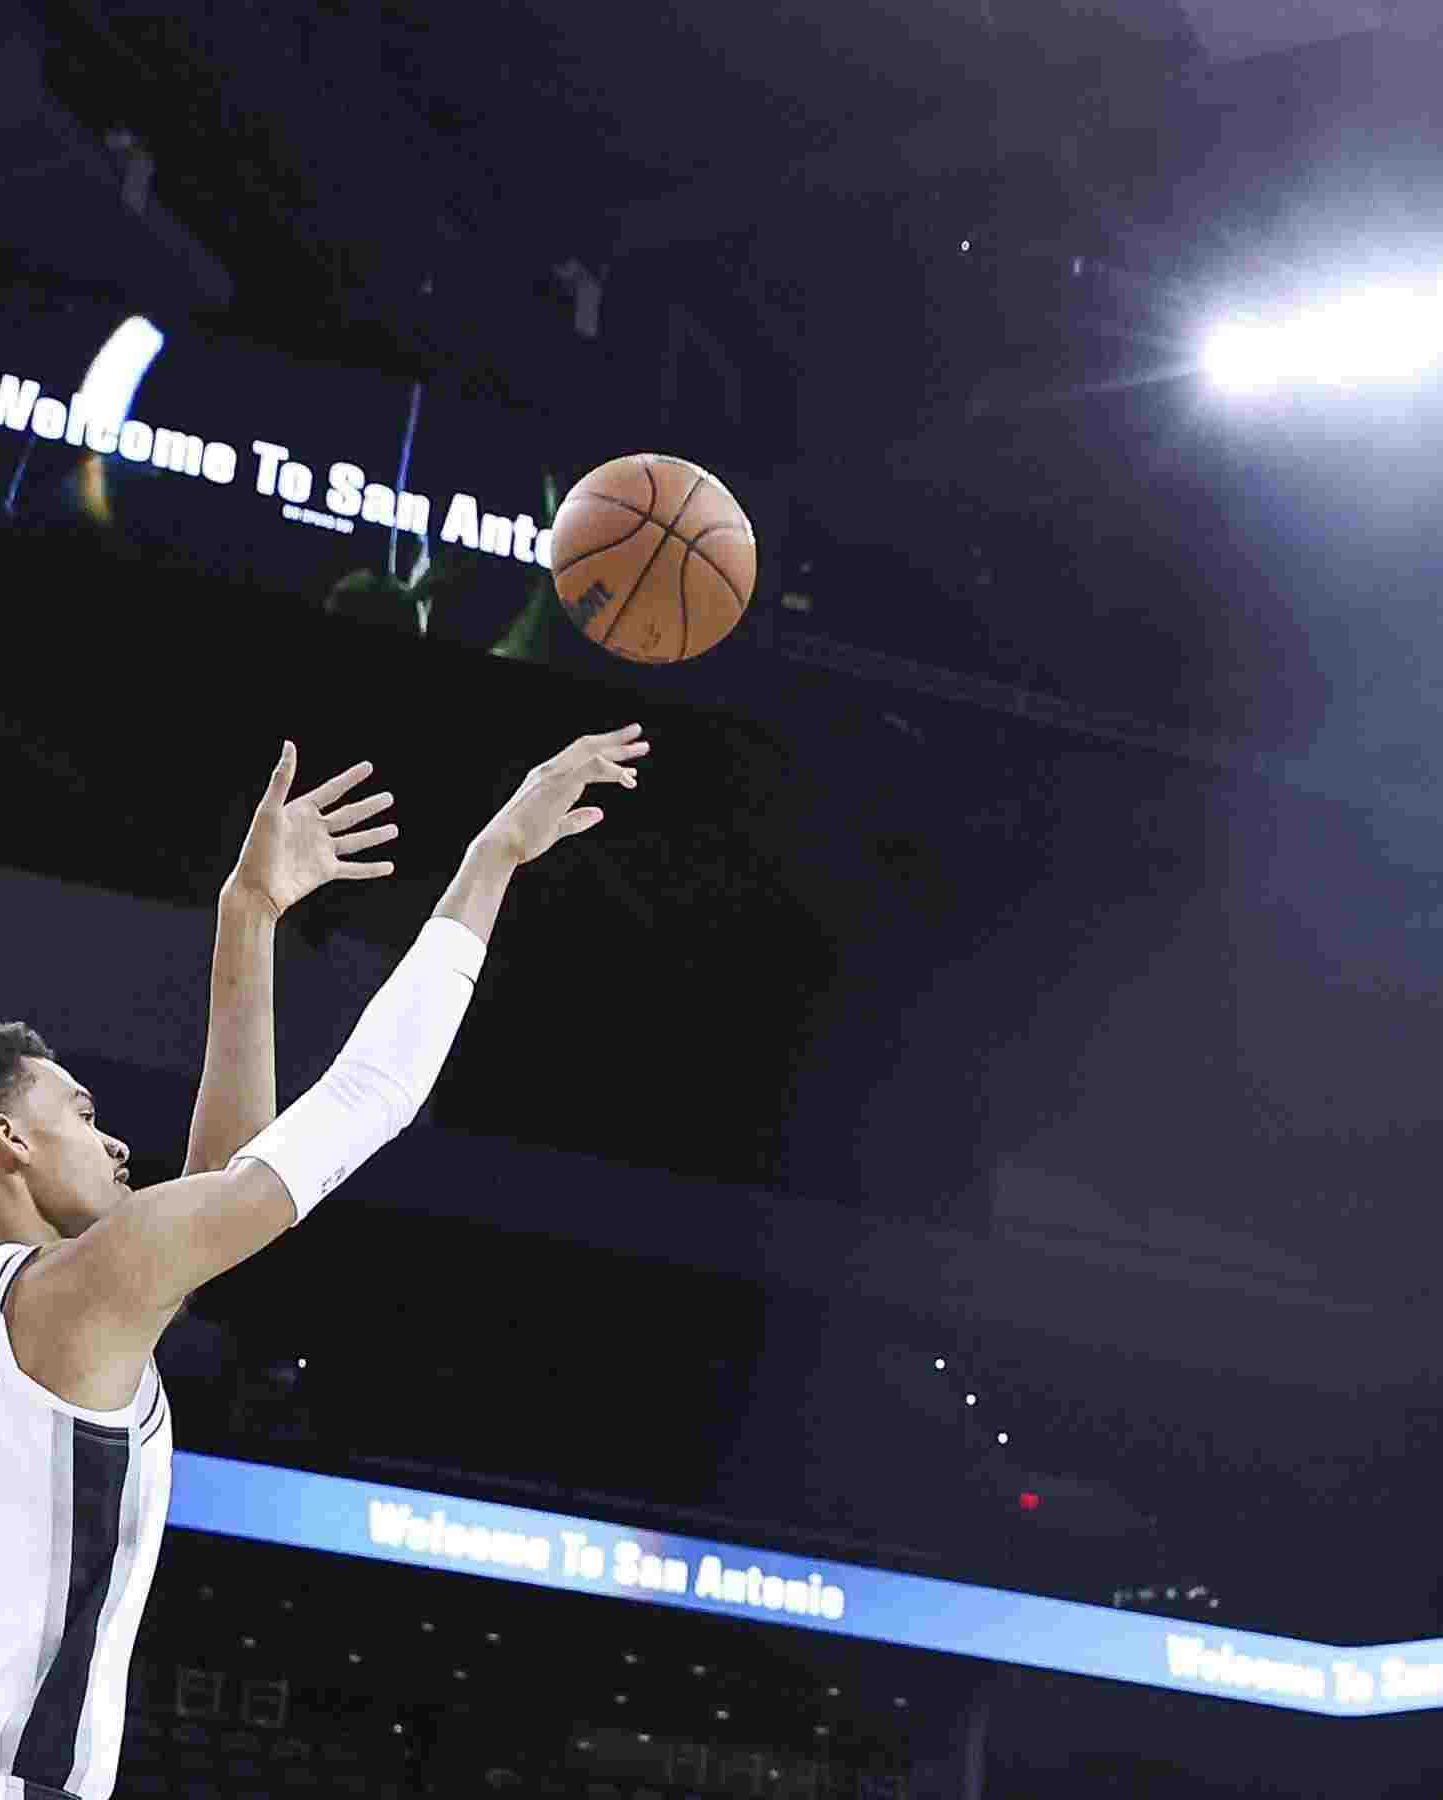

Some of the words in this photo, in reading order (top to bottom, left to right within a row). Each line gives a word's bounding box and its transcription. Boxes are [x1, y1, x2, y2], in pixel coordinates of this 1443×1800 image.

[252, 440, 313, 504] To
[325, 462, 431, 537] San
[440, 494, 554, 569] Anto
[368, 1498, 550, 1571] Welcome
[560, 1530, 605, 1579] To
[613, 1540, 688, 1594] San
[694, 1554, 845, 1620] Antonio
